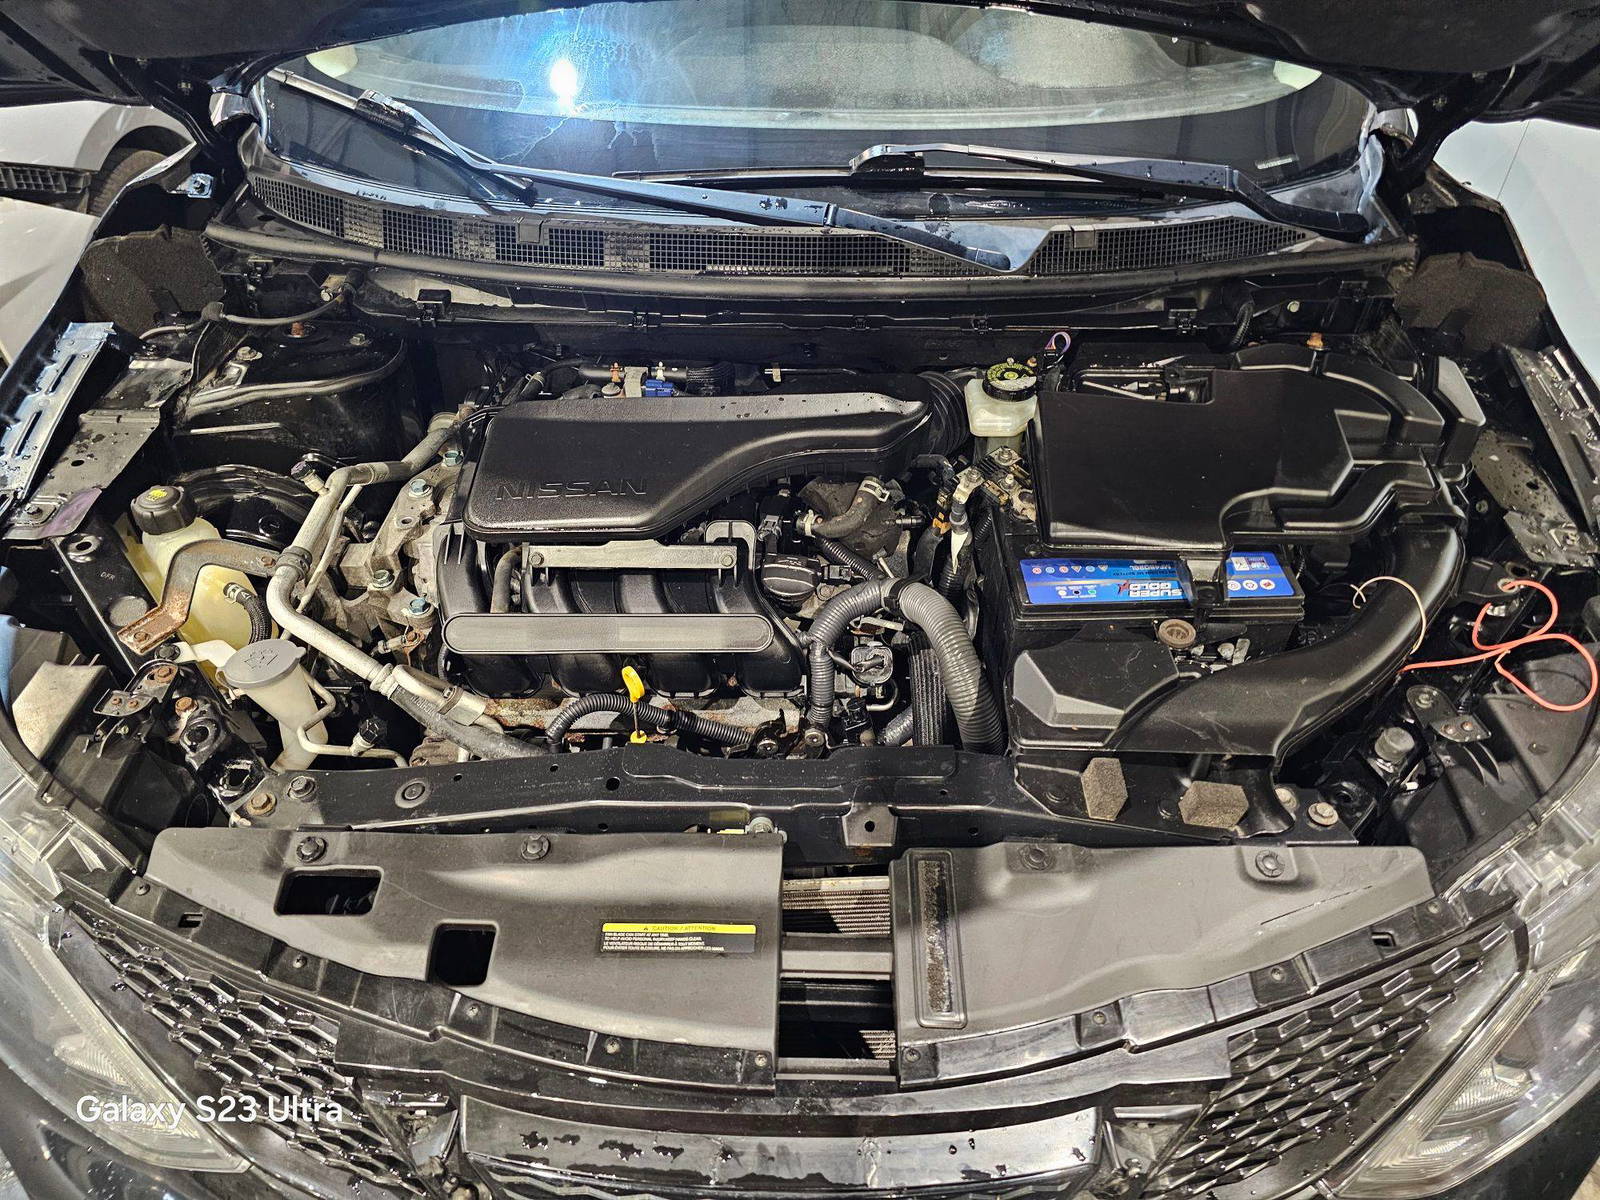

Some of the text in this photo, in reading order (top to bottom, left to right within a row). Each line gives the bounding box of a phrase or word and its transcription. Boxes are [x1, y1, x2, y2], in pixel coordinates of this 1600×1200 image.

[495, 479, 647, 501] NISSAN
[1129, 582, 1172, 591] GOLD
[1129, 588, 1183, 598] SUPER
